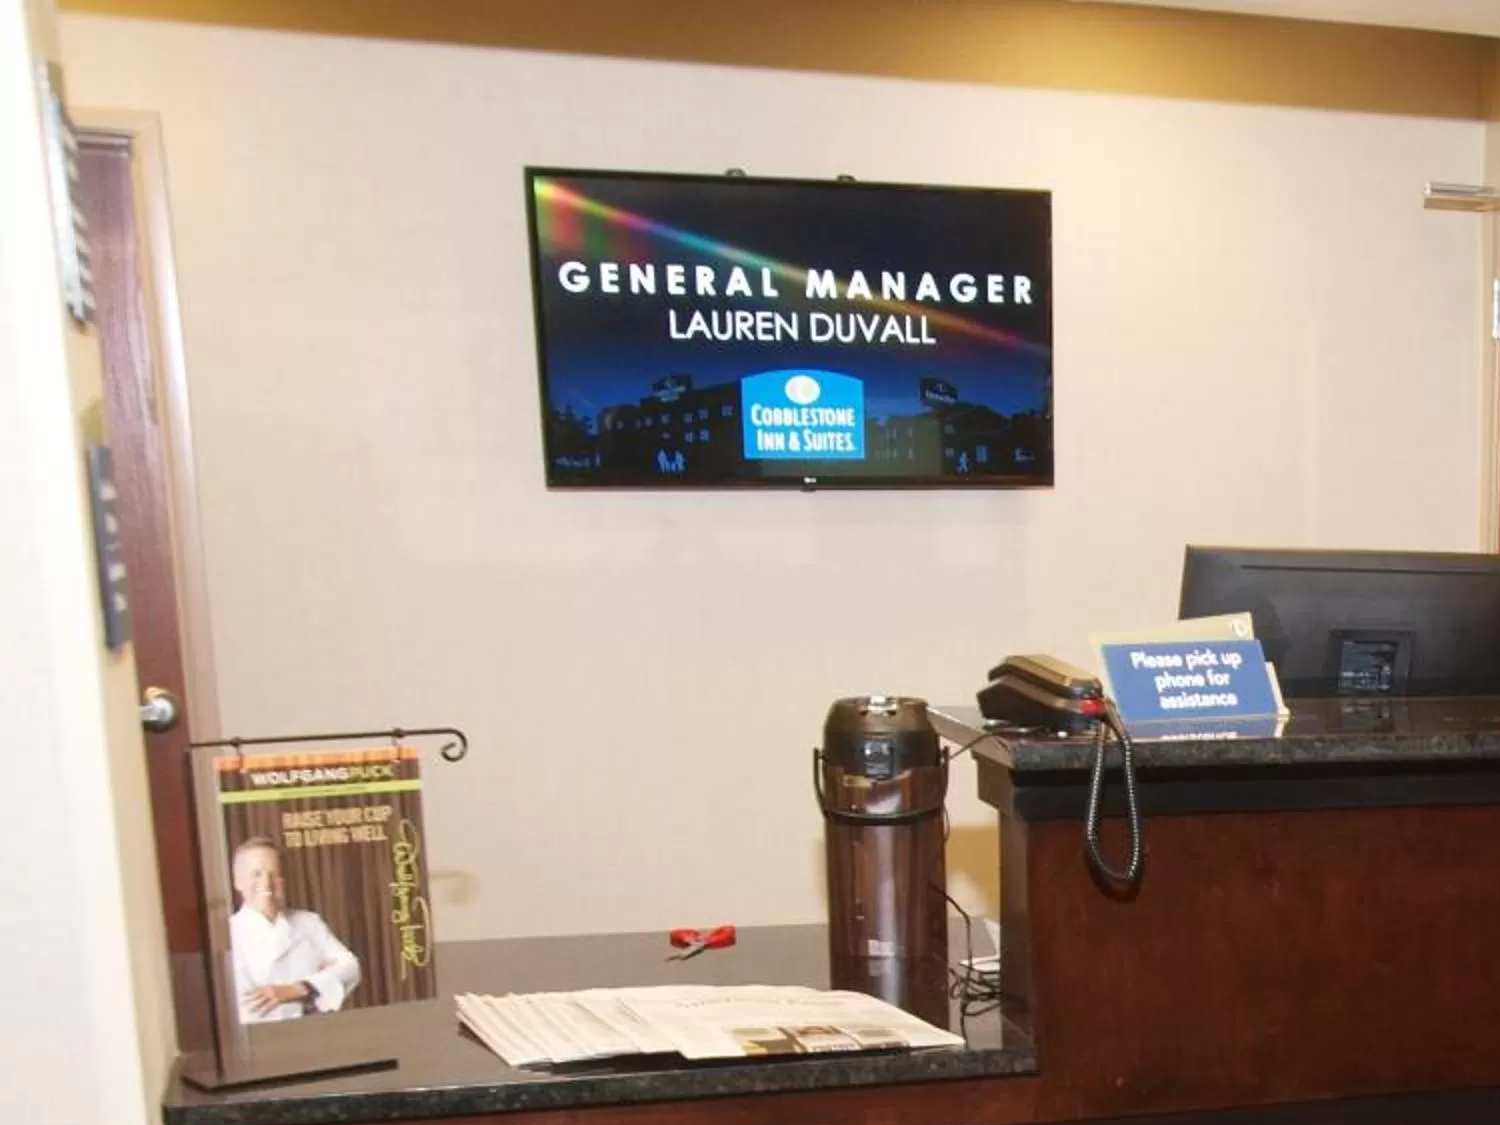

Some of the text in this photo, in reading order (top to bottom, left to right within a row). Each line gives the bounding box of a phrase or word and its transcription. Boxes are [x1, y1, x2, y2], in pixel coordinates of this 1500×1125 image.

[558, 261, 1032, 305] GENERAL MANAGER
[669, 309, 936, 345] LAUREN DUVALL
[751, 403, 856, 427] COBBLESTONE
[757, 428, 855, 452] INN & SUITES
[1129, 649, 1242, 671] Please pick up
[1153, 669, 1230, 693] phone for
[1159, 692, 1239, 711] assistance
